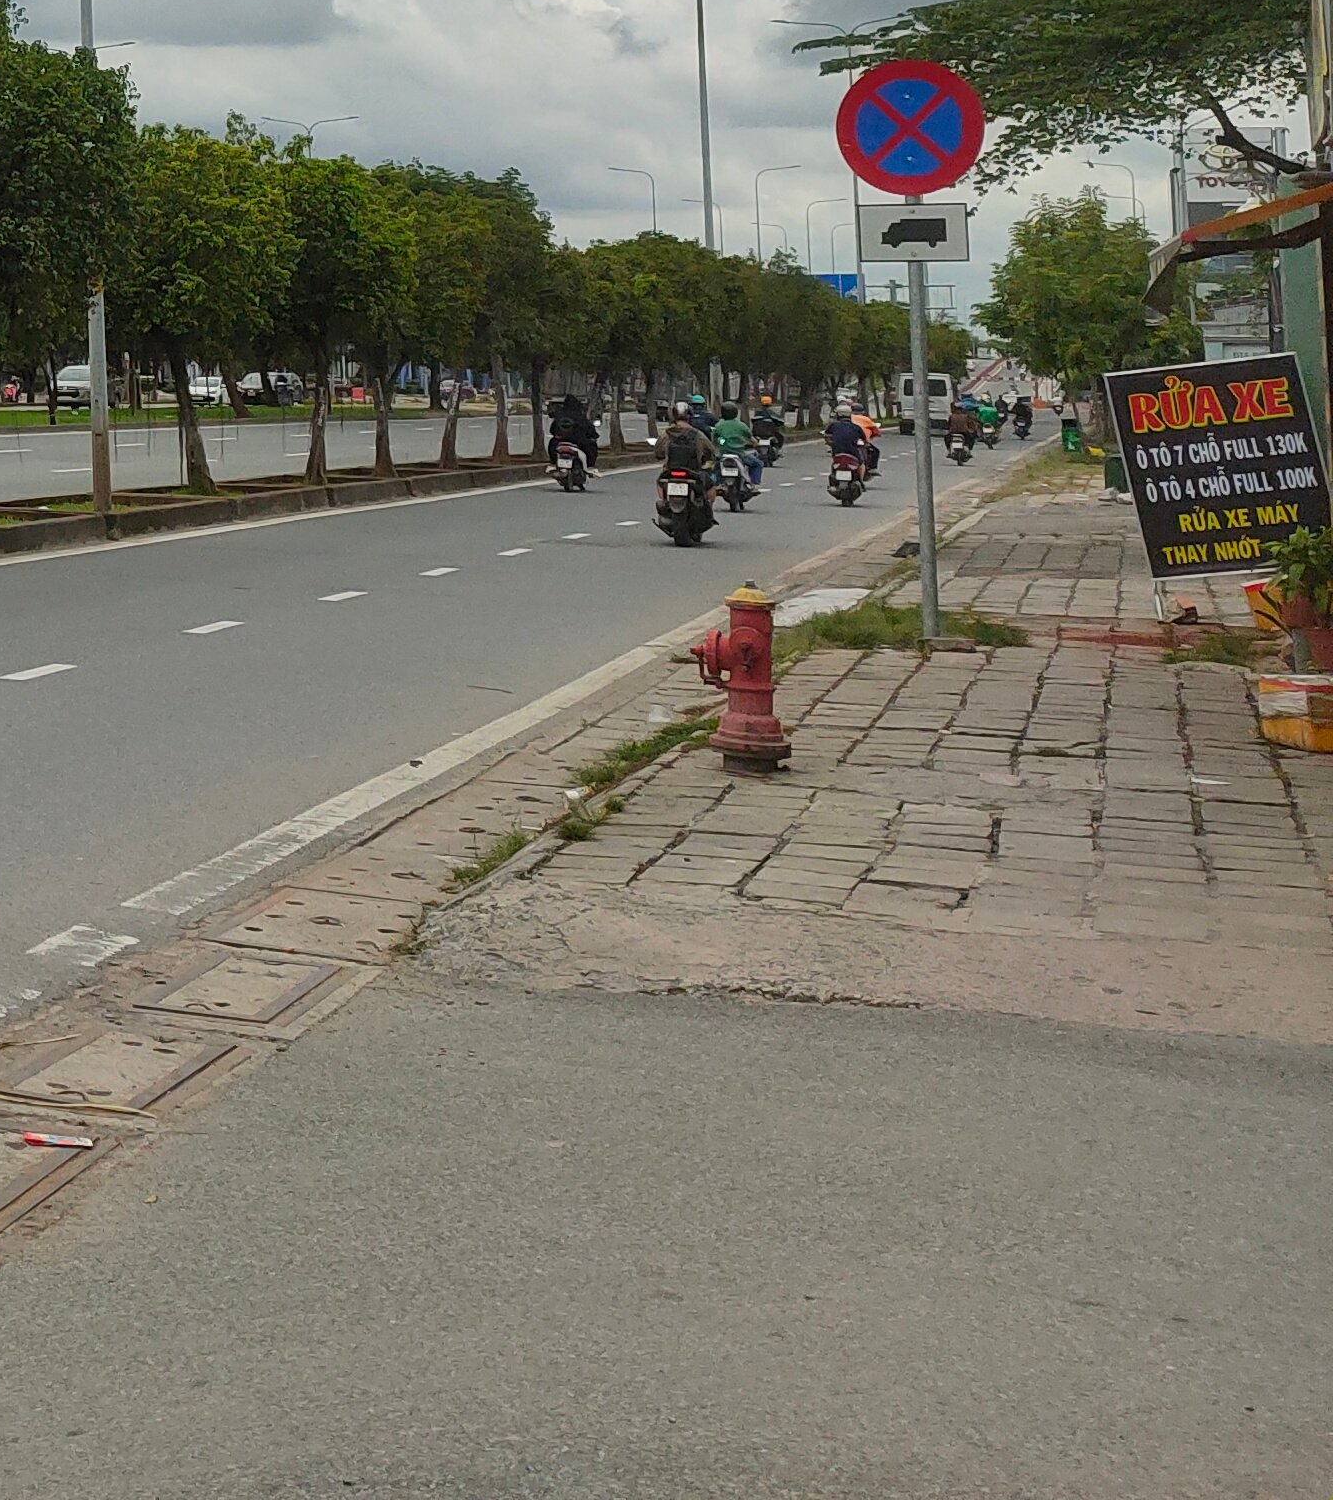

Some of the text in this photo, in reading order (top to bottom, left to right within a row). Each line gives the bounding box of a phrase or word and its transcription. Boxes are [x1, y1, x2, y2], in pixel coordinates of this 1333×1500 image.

[1128, 375, 1294, 434] RỬA XE
[1136, 432, 1309, 470] Ô TÔ 7 CHỖ FULL 130K
[1145, 466, 1319, 503] Ô TÔ 4 CHỖ FULL 100K
[1178, 500, 1299, 533] RỬA XE MÁY
[1162, 534, 1261, 565] THAY NHỚT
